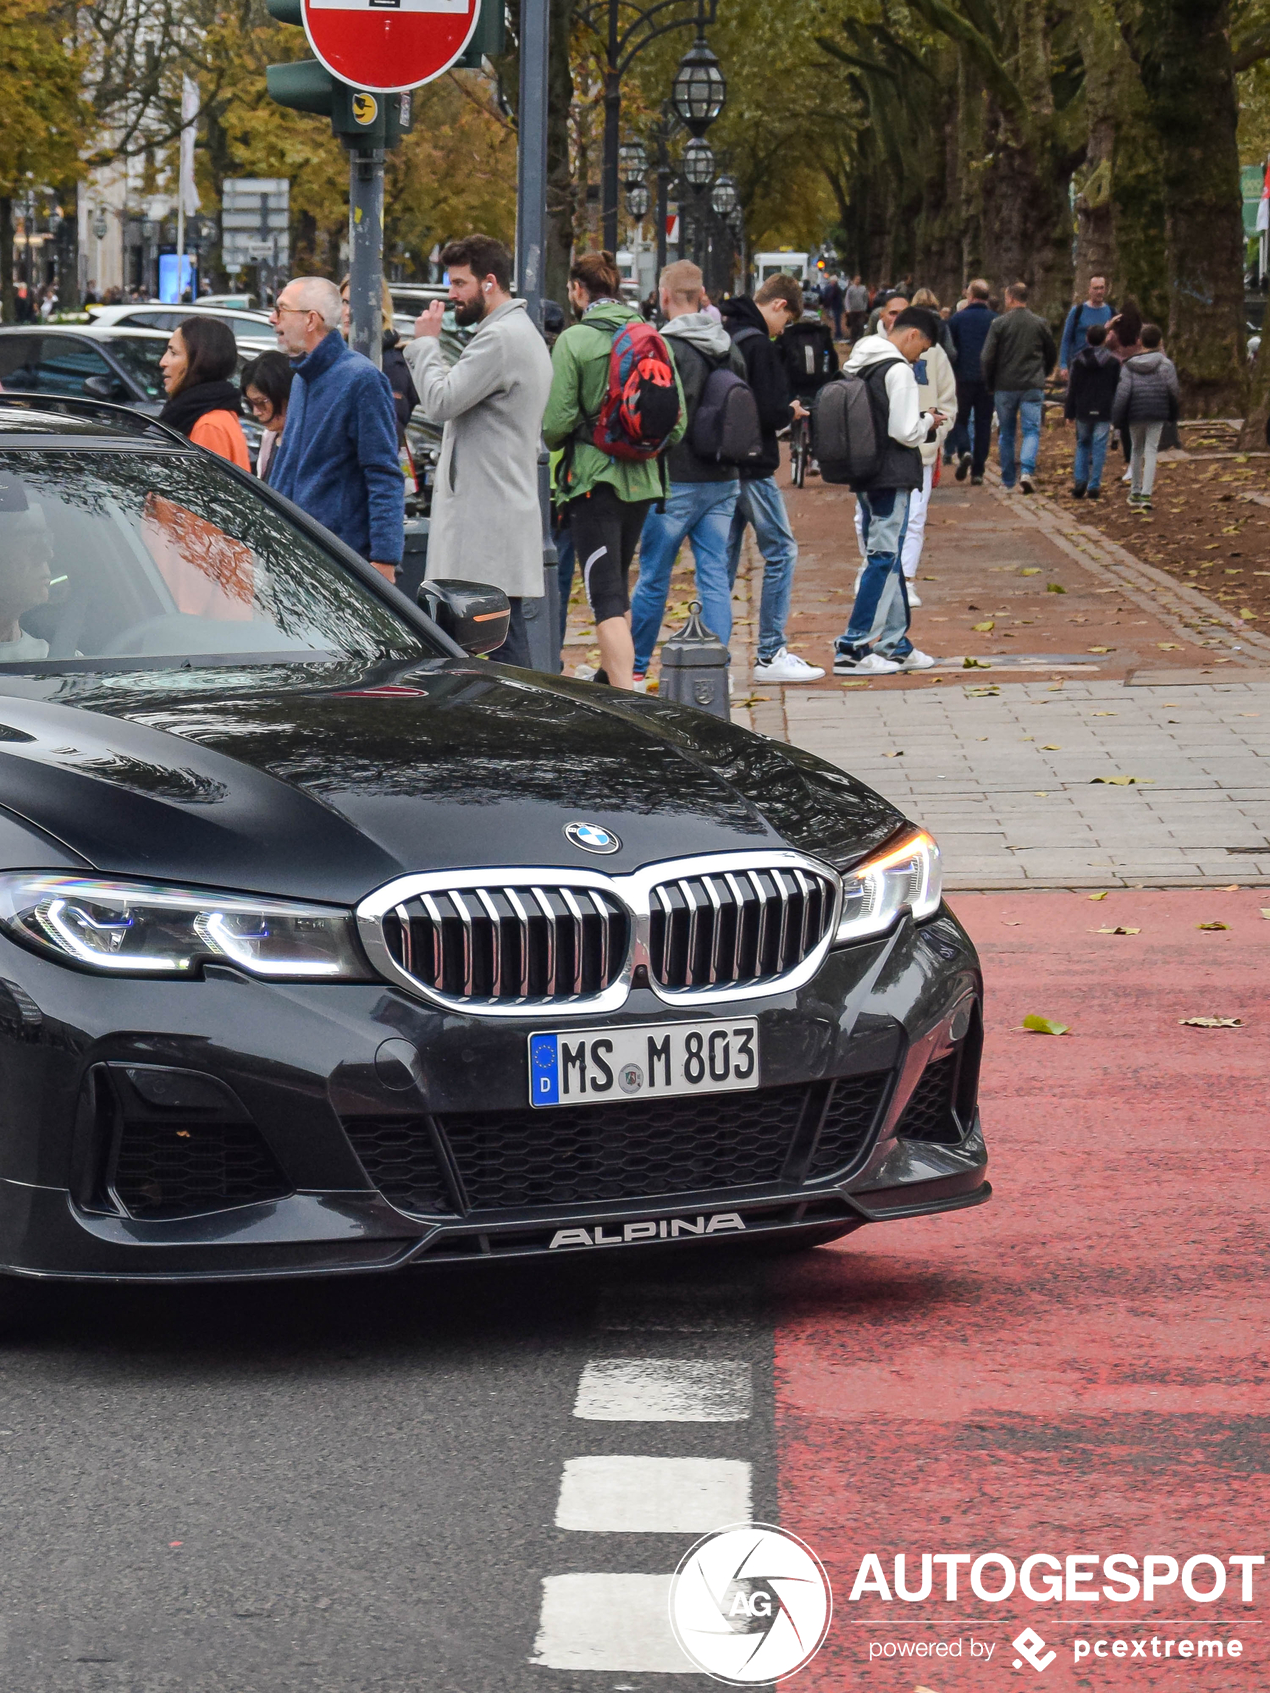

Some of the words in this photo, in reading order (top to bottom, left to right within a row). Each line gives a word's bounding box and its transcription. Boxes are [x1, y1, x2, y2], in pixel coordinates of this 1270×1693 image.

[562, 1038, 614, 1094] MS
[647, 1034, 672, 1087] M
[684, 1027, 755, 1084] 803
[540, 1077, 551, 1093] D
[549, 1212, 746, 1248] ALPINA
